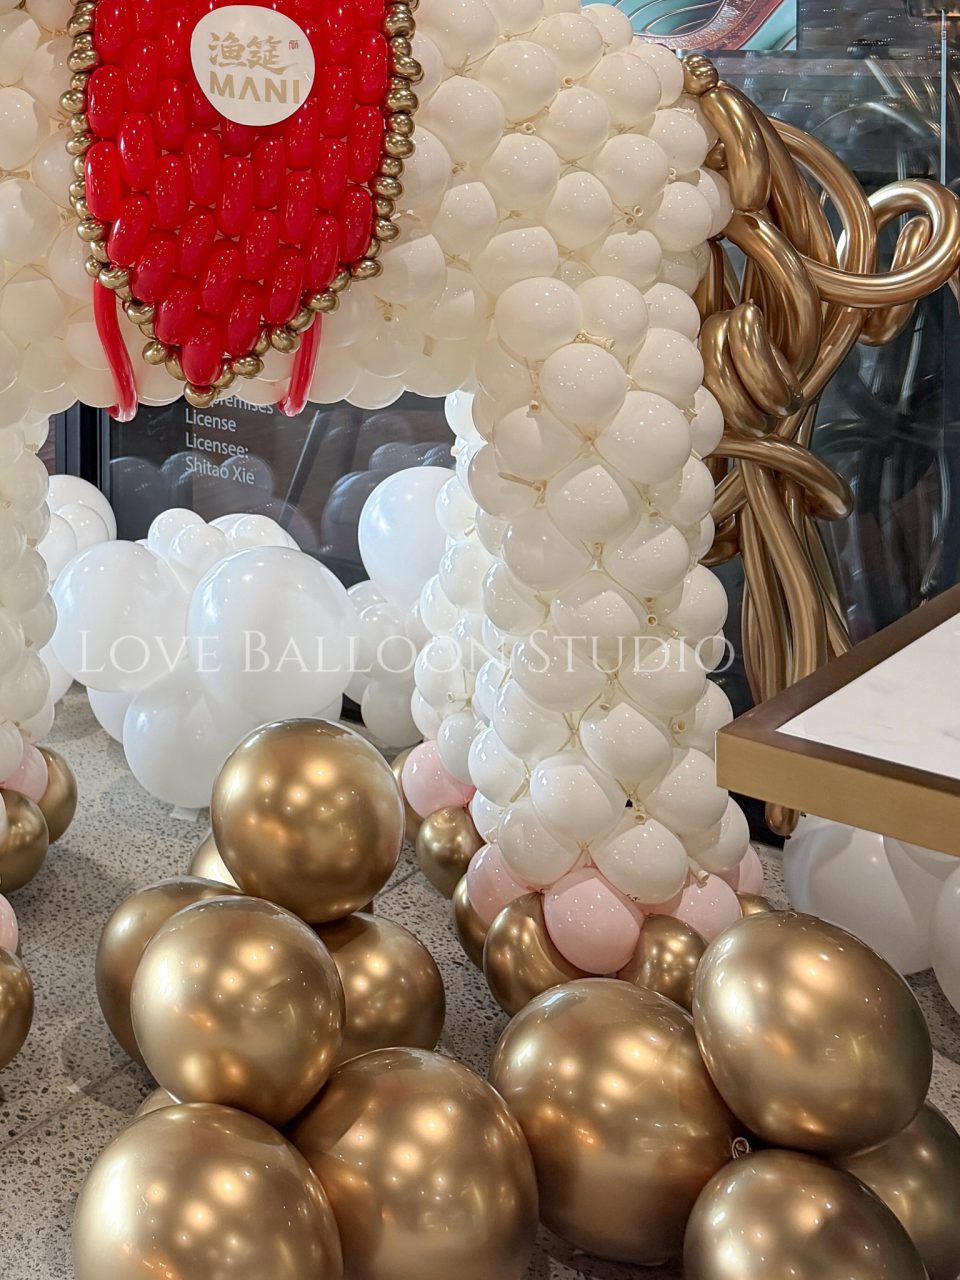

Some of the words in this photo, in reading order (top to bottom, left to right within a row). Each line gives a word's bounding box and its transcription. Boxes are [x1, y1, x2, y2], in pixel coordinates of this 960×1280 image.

[209, 71, 300, 104] MANI
[186, 408, 236, 432] License
[186, 432, 249, 459] Licensee:
[186, 456, 229, 479] Shitao
[233, 465, 255, 485] Xie
